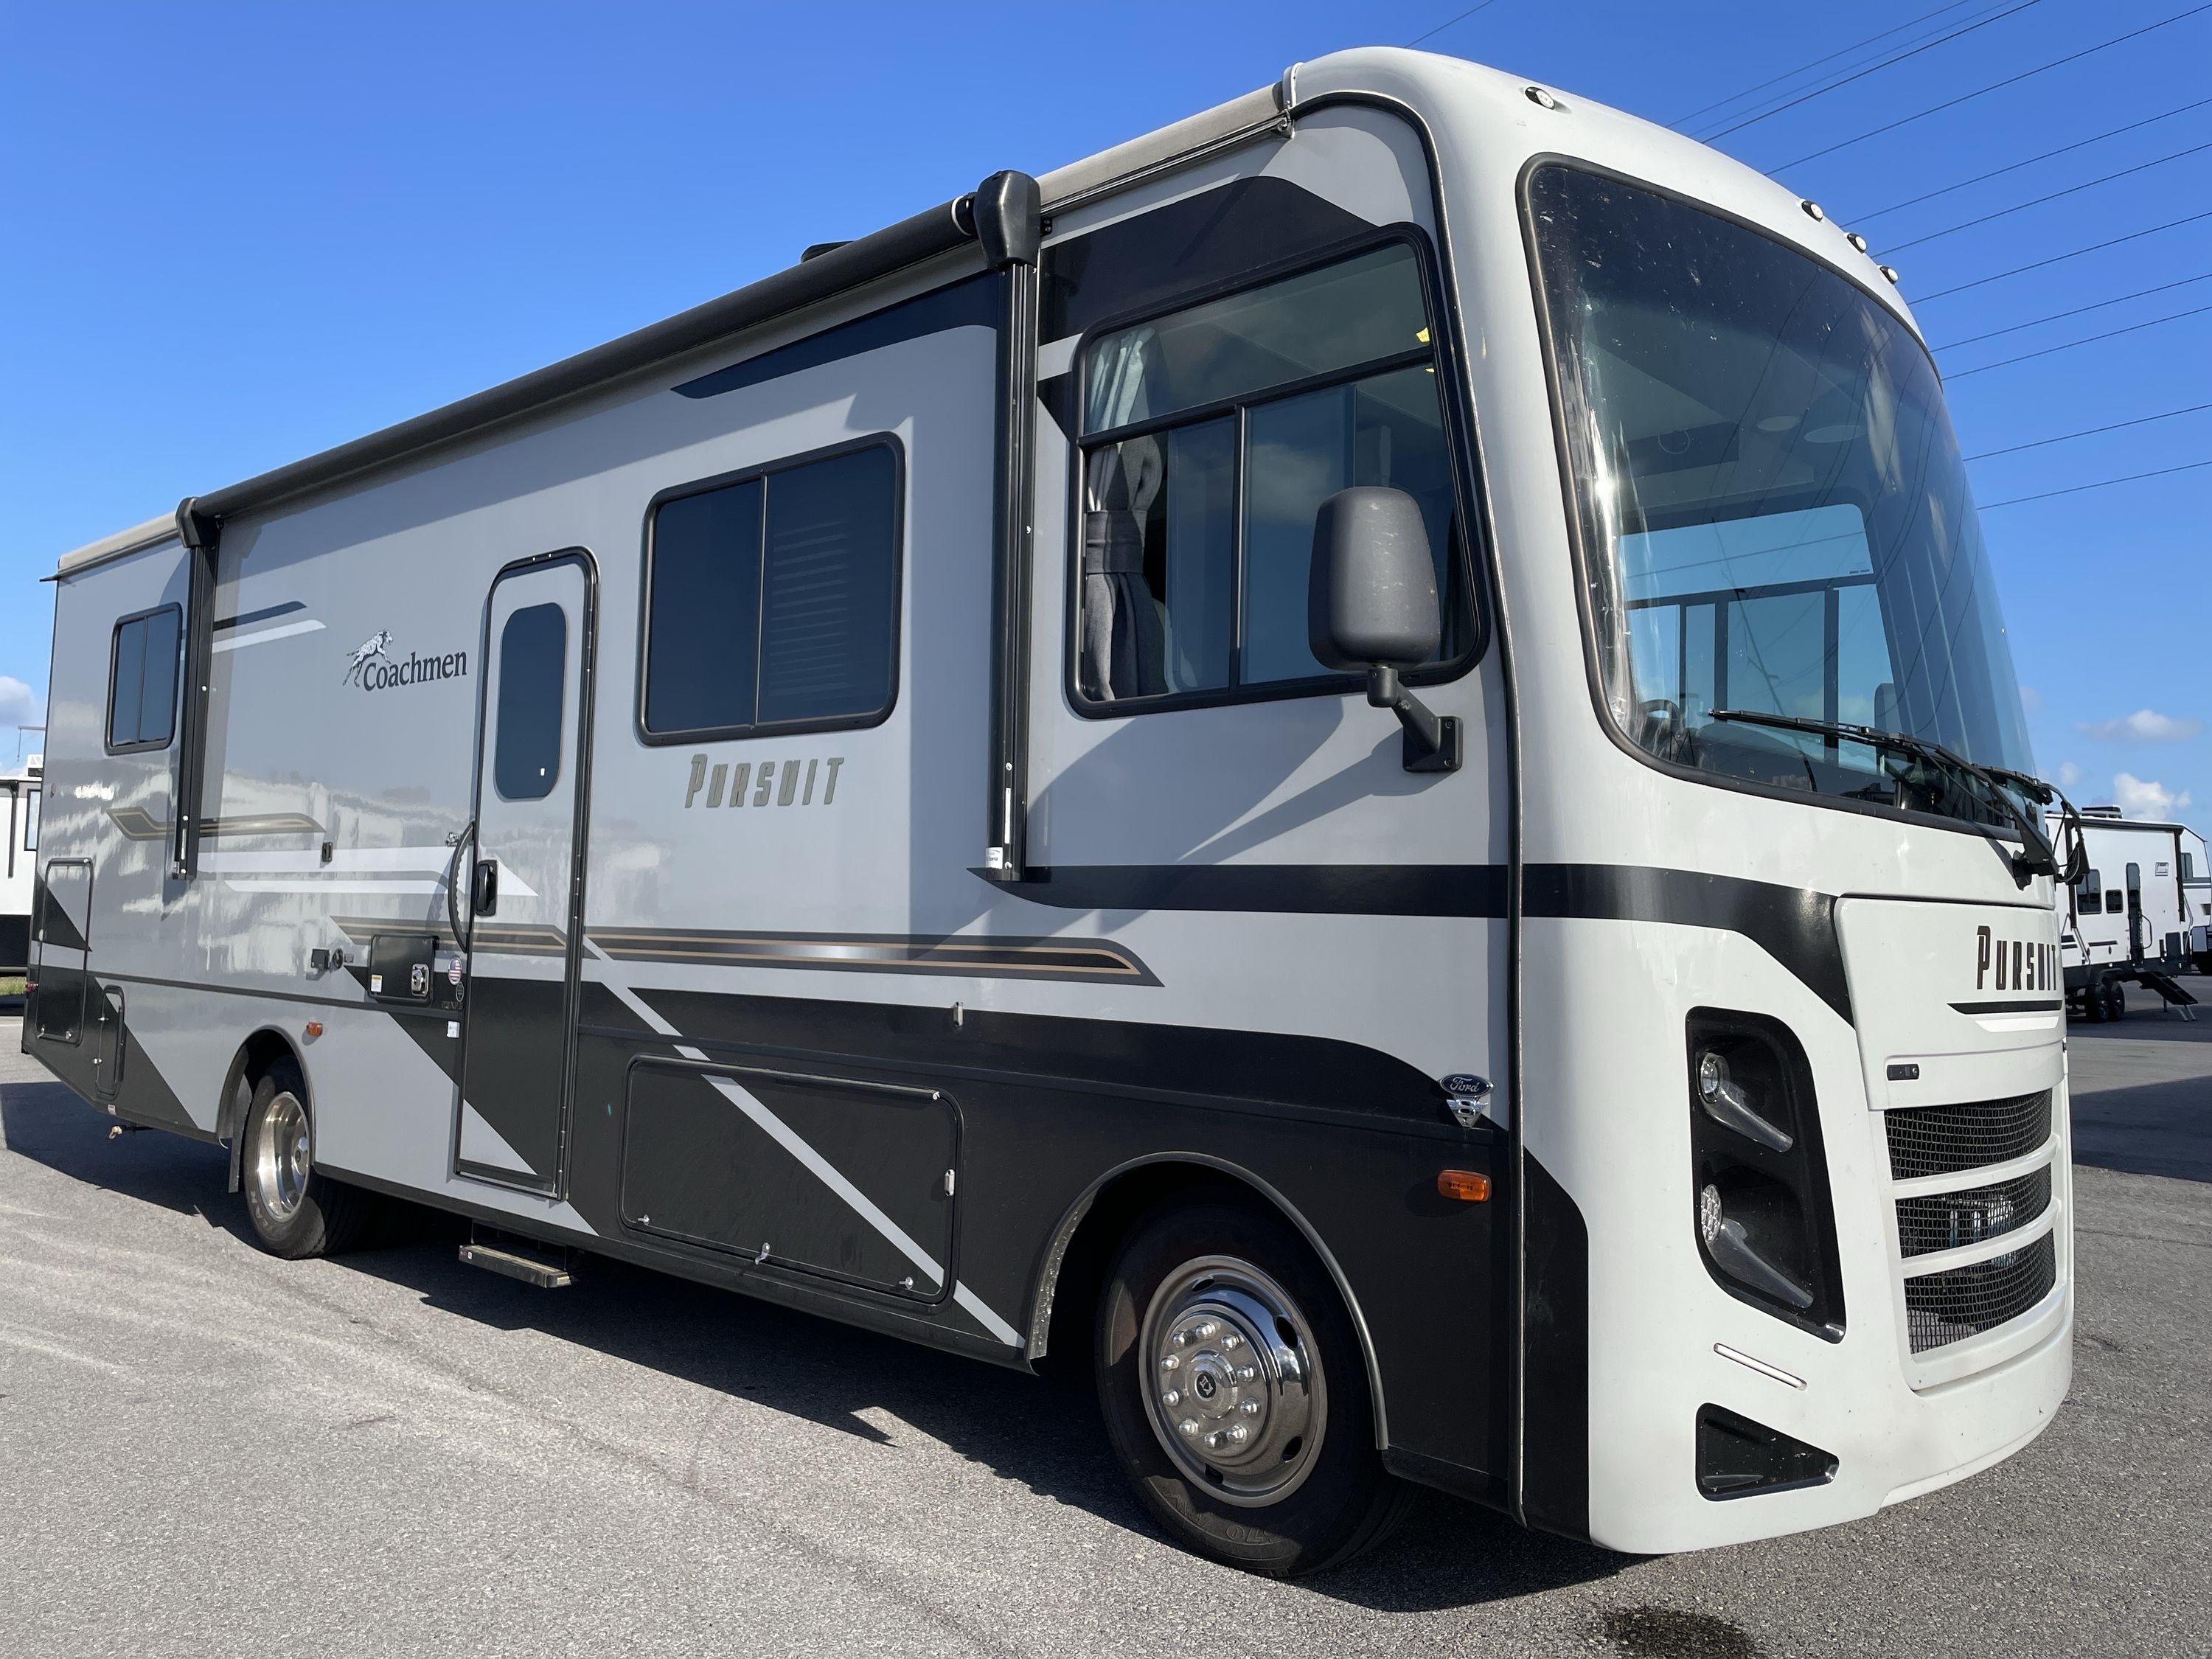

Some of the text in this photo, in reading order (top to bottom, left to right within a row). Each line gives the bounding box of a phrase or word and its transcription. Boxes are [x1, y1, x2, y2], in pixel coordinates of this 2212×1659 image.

[364, 651, 467, 692] Coachmen
[684, 753, 845, 809] PURSUIT
[1976, 925, 2056, 991] PURSUIT
[1450, 1077, 1481, 1093] Ford
